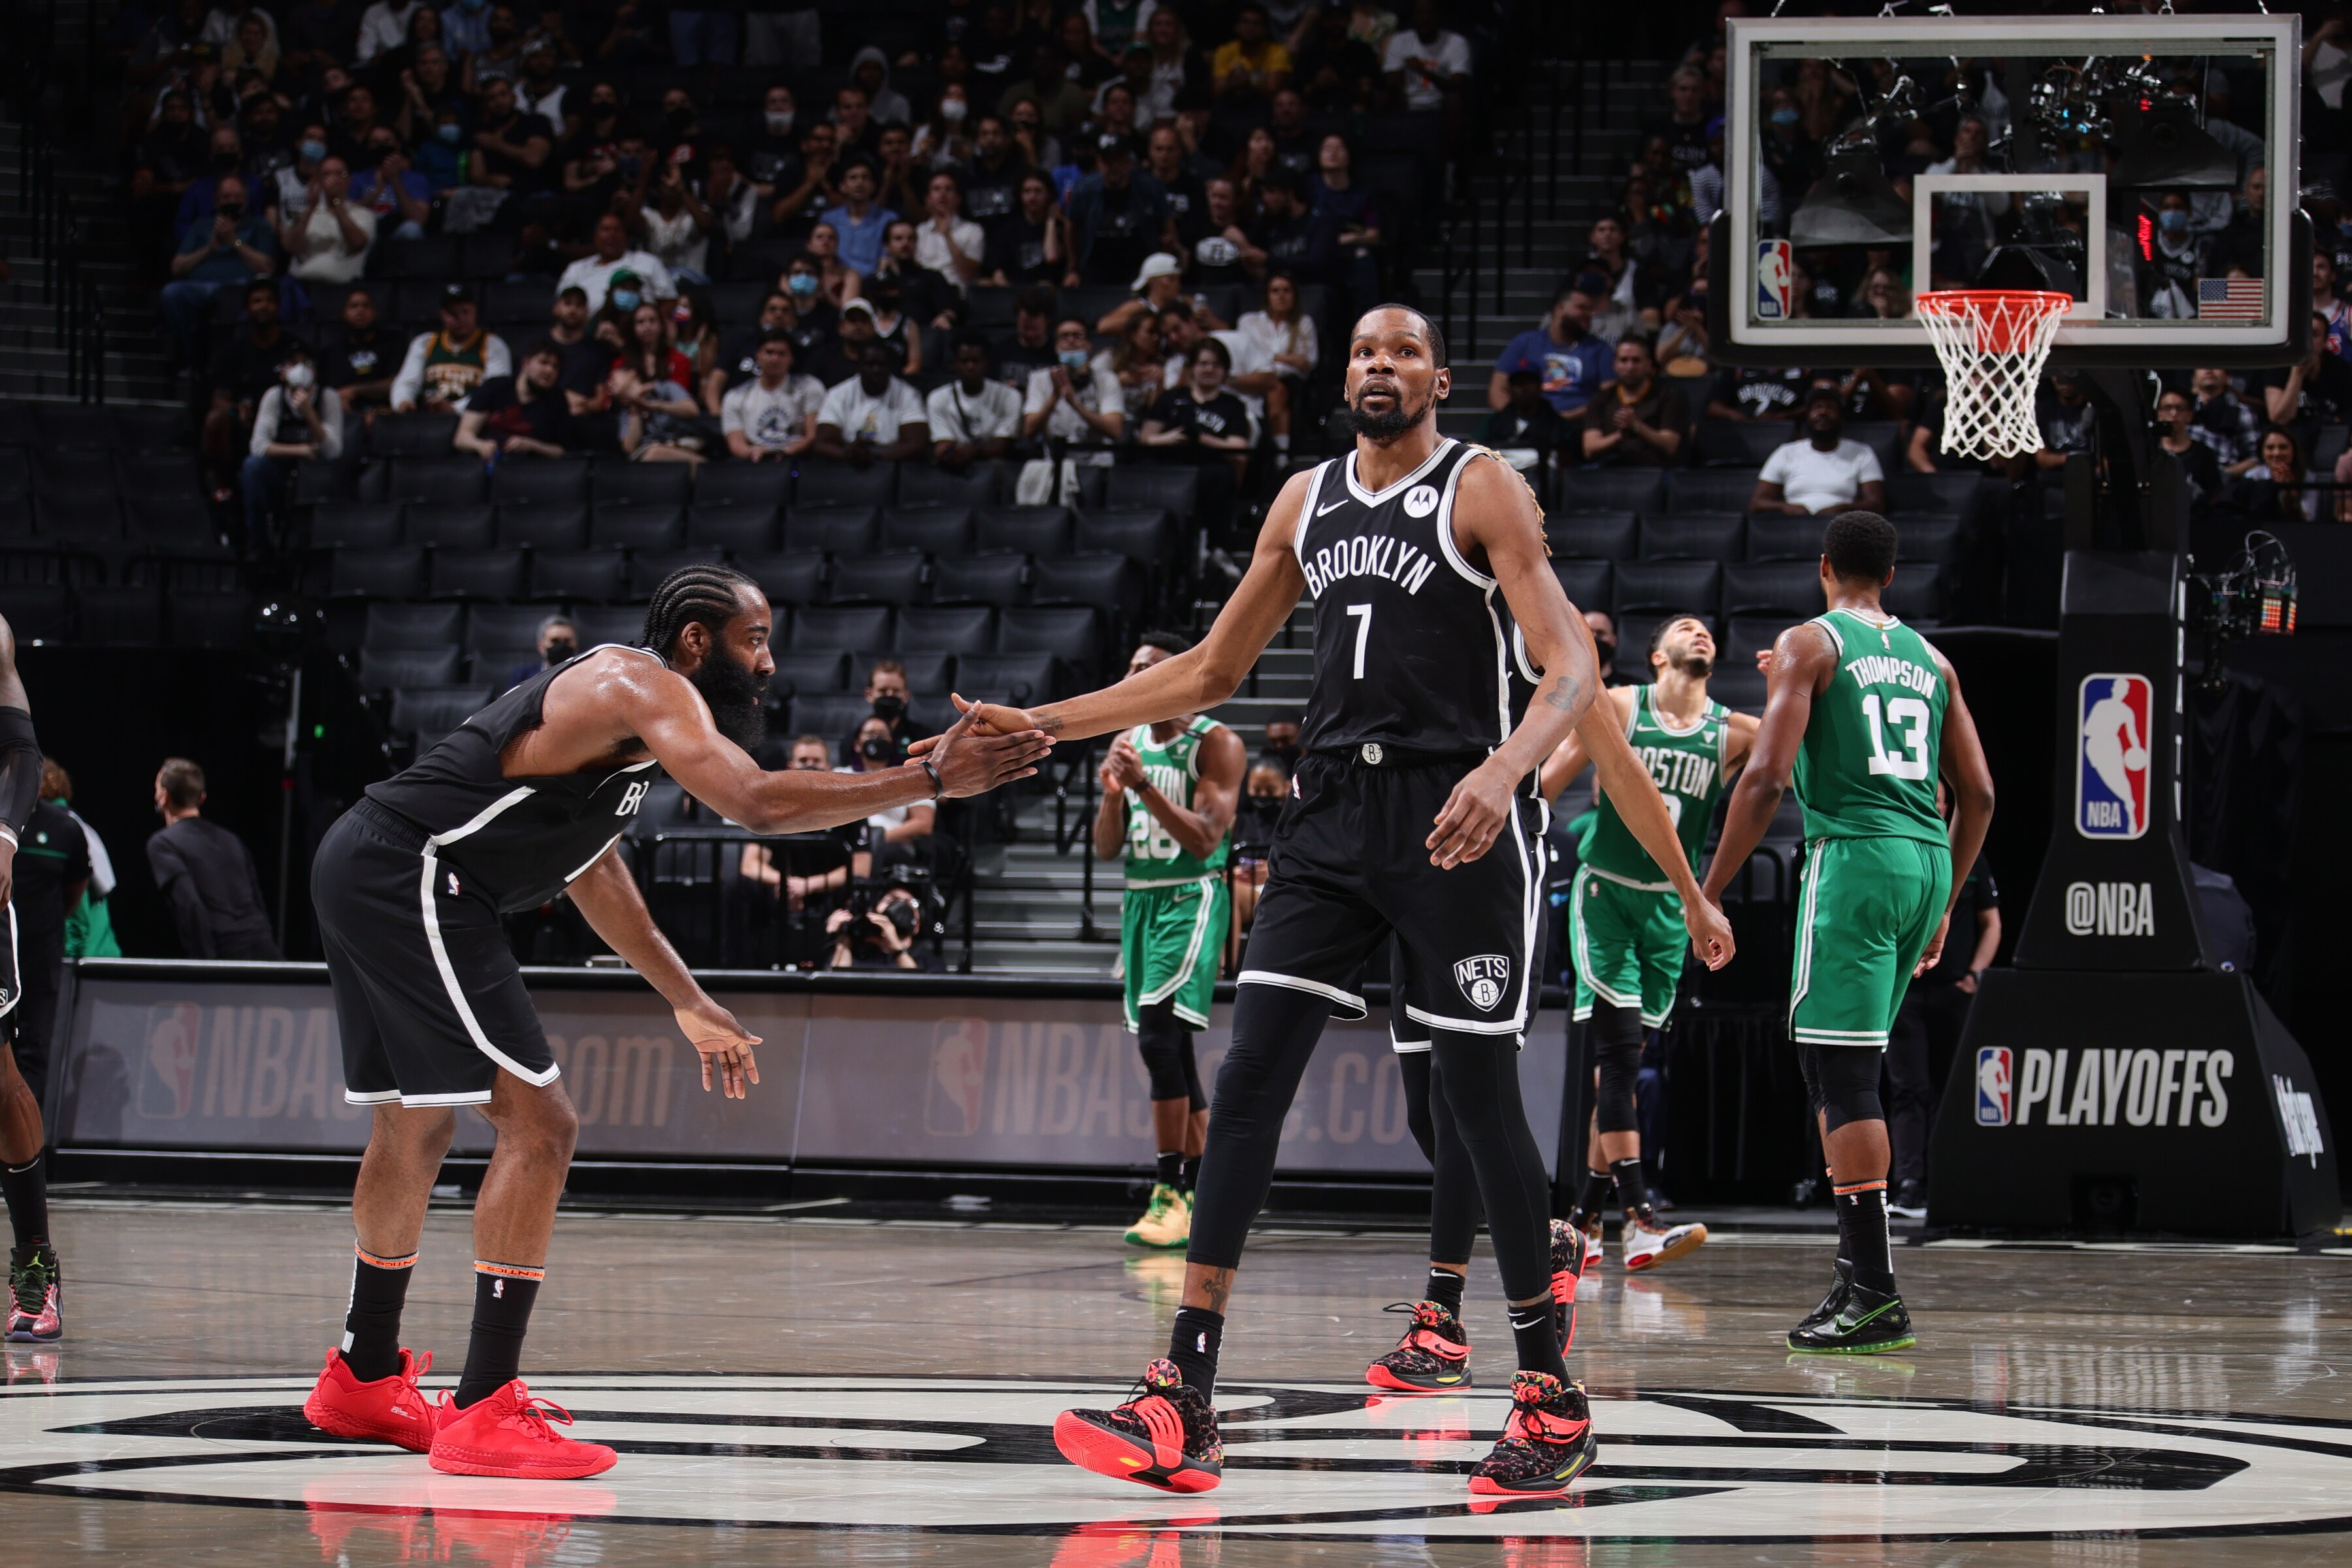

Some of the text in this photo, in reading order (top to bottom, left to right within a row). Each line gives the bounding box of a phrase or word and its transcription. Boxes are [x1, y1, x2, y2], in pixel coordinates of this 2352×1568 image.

[1304, 535, 1437, 600] BROOKLYN
[1347, 604, 1371, 679] 7
[1844, 655, 1937, 699] THOMPSON
[1368, 744, 1377, 762] B
[1862, 694, 1930, 781] 13
[1633, 745, 1717, 800] OSTON
[2087, 801, 2122, 828] NBA
[2065, 881, 2155, 936] @NBA
[1458, 957, 1507, 985] NETS
[1480, 983, 1490, 1003] B
[1980, 1107, 1999, 1120] NBA
[2016, 1049, 2234, 1127] PLAYOFFS
